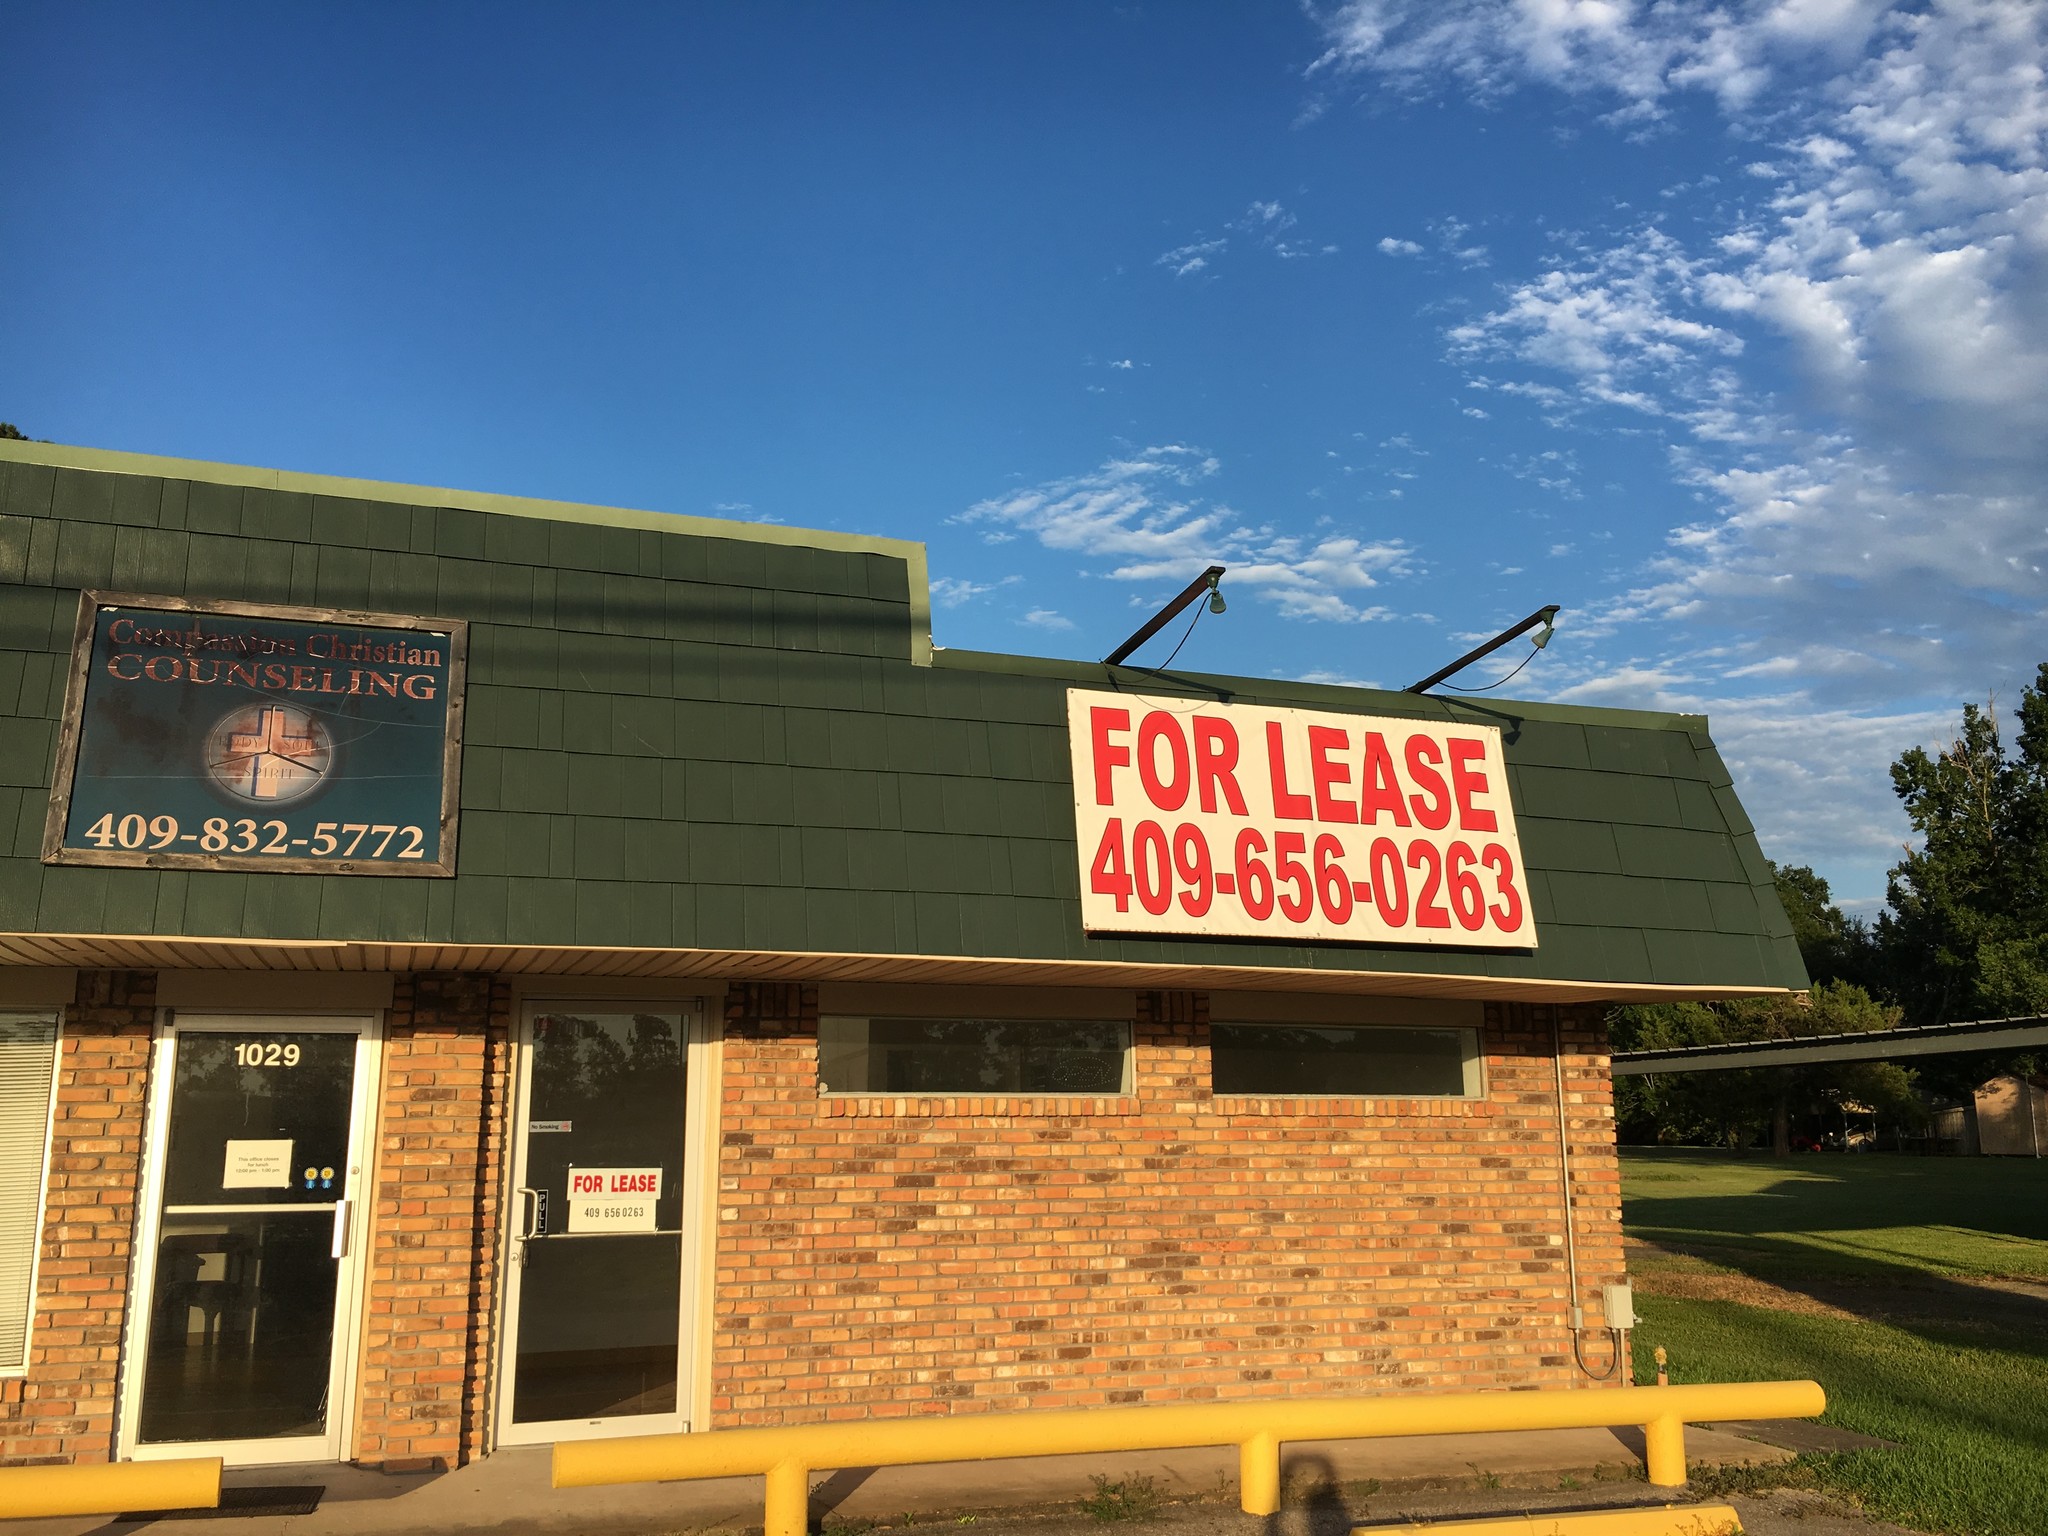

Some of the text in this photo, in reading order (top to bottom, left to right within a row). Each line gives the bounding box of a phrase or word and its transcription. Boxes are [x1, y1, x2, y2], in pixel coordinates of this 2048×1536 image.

[305, 633, 442, 667] Christian
[107, 653, 437, 700] COUNSELING
[218, 735, 262, 748] BODY
[244, 767, 295, 780] SPIRIT
[1090, 706, 1499, 833] FOR LEASE
[85, 812, 425, 860] 409-832-5772
[1091, 817, 1523, 933] 409-656-0263
[234, 1043, 301, 1067] 1029
[574, 1175, 657, 1193] FOR LEASE
[538, 1193, 547, 1230] PULL
[584, 1207, 600, 1218] 409
